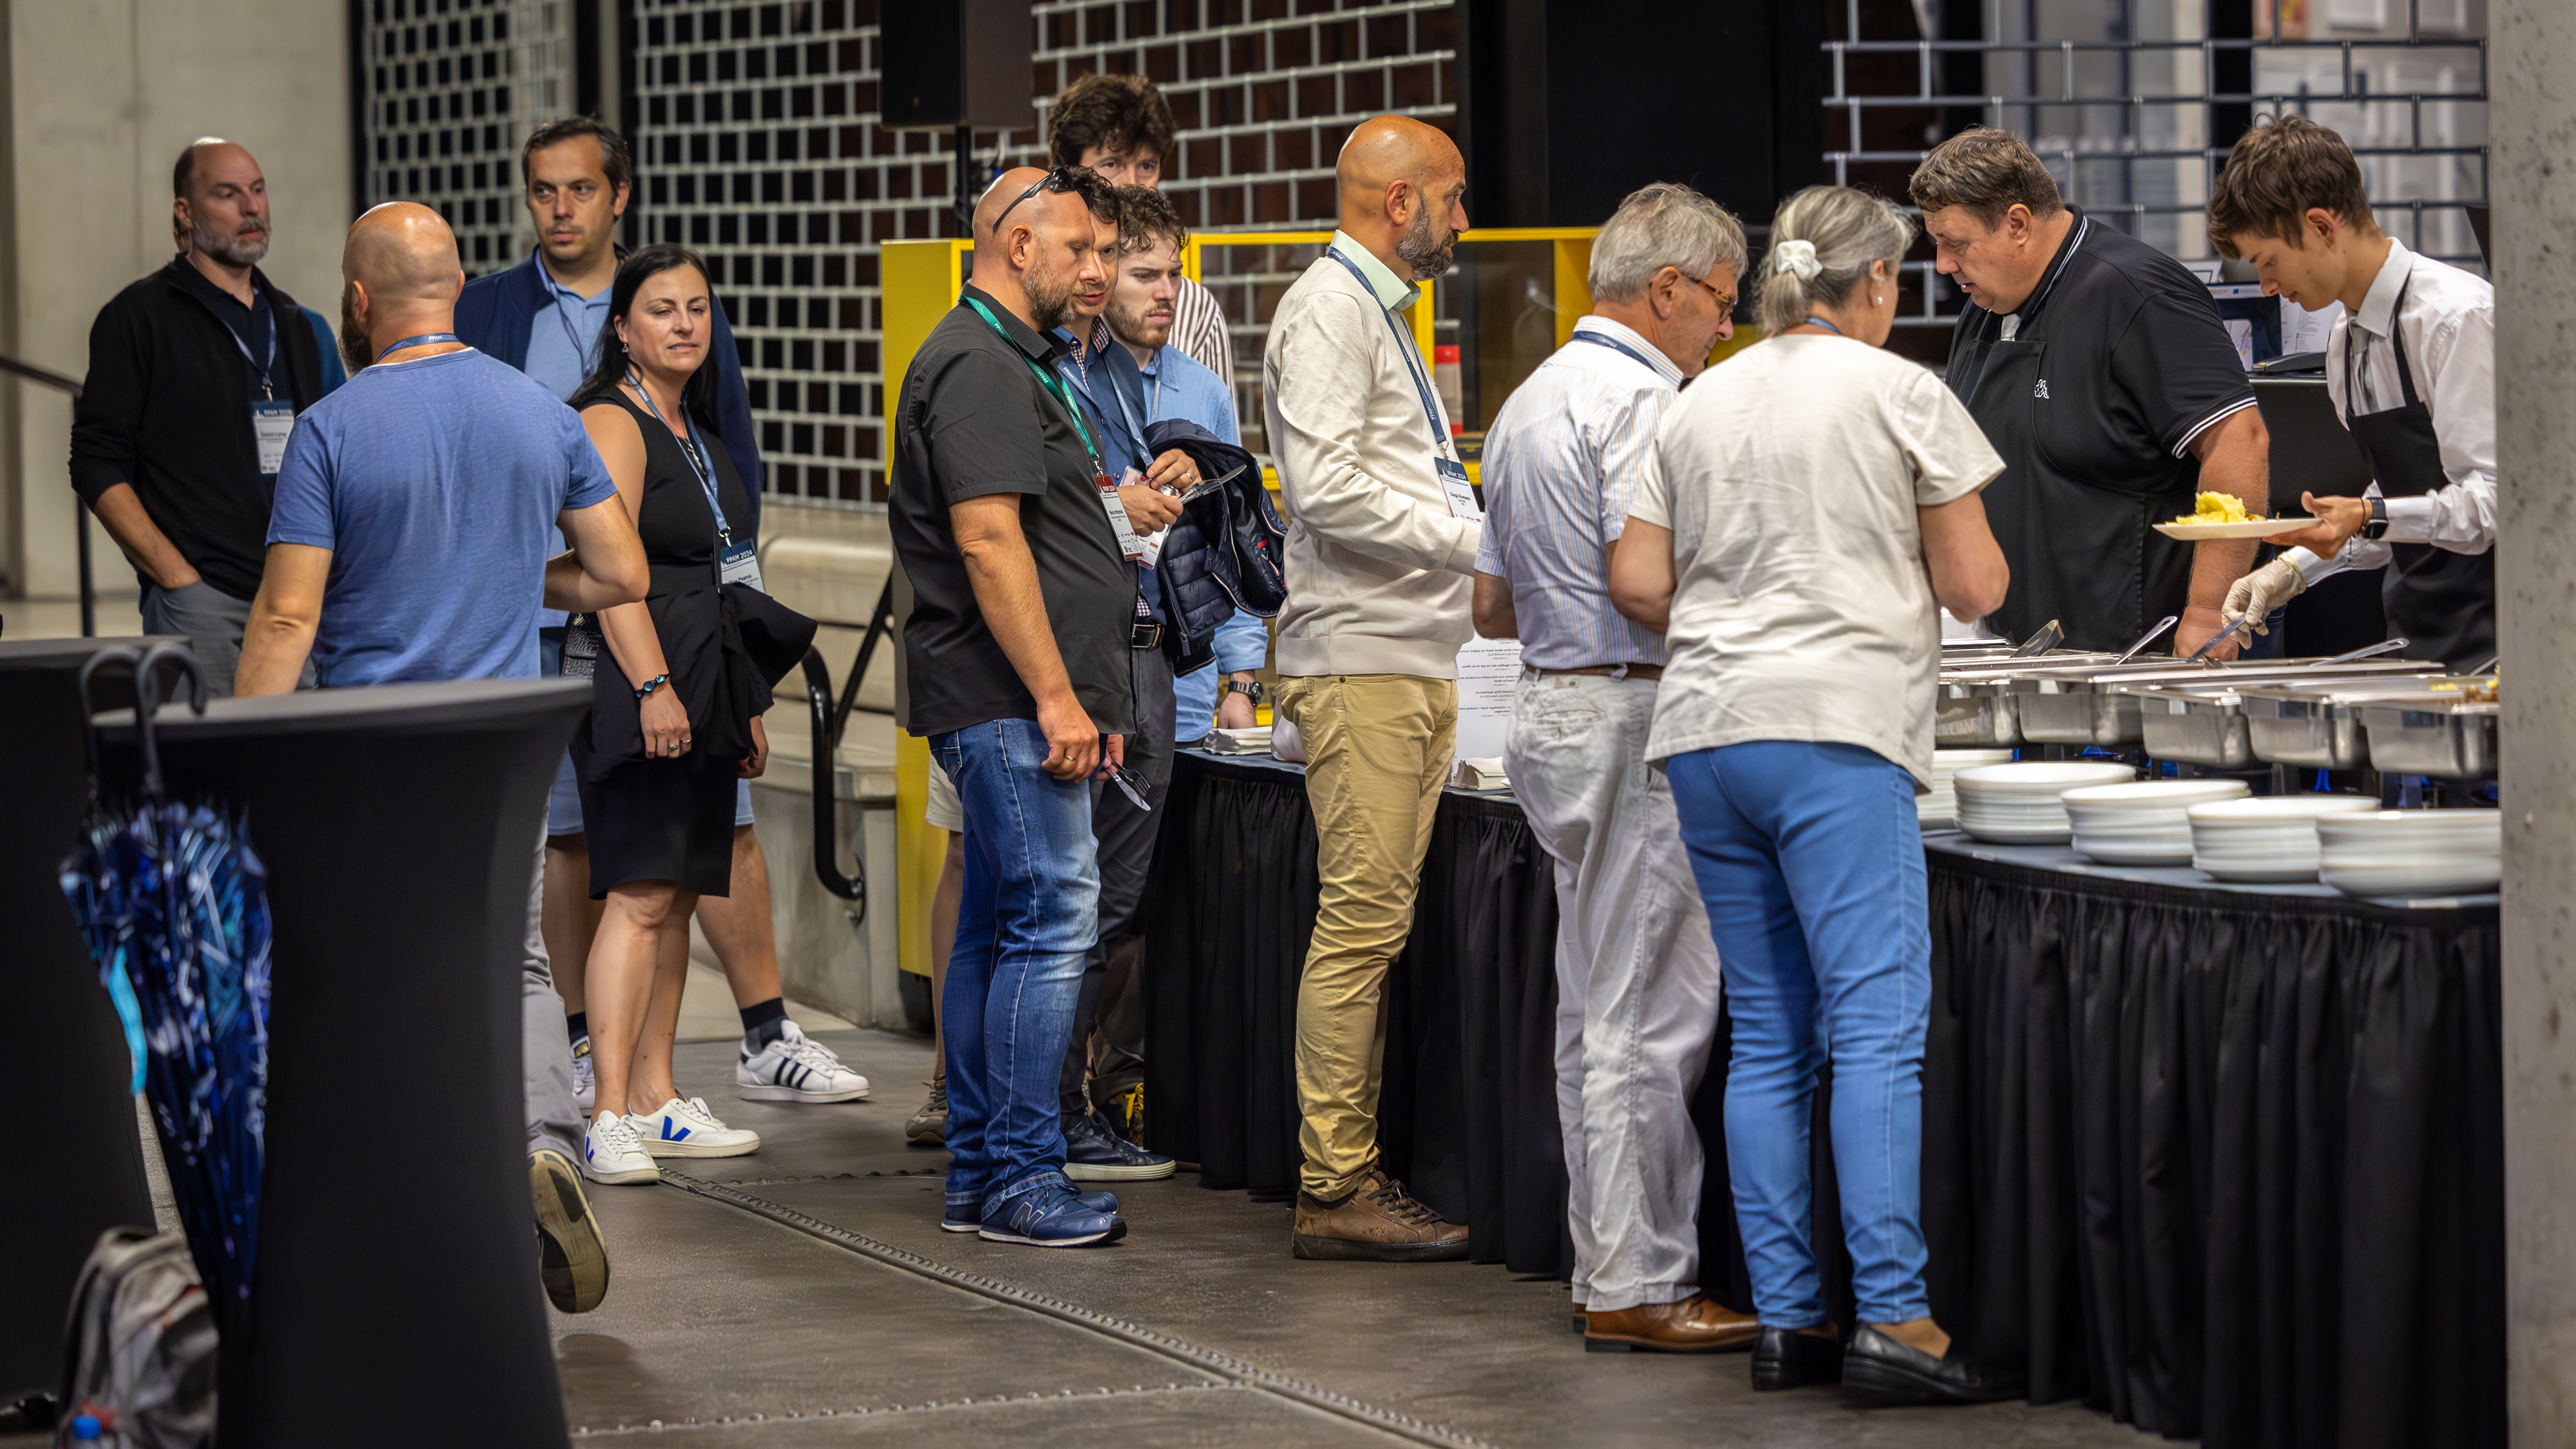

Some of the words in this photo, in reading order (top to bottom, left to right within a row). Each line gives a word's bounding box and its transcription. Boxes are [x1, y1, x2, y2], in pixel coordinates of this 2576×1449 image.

[1332, 251, 1344, 260] PPAM
[994, 322, 1005, 335] PPAM
[1038, 371, 1049, 384] PPAM
[1063, 366, 1074, 379] PPAM
[1066, 395, 1075, 407] PPAM
[1426, 406, 1435, 421] PPAM
[726, 554, 740, 564] PPAM
[739, 549, 752, 559] 2024
[661, 1116, 691, 1142] V
[1010, 1201, 1045, 1237] N
